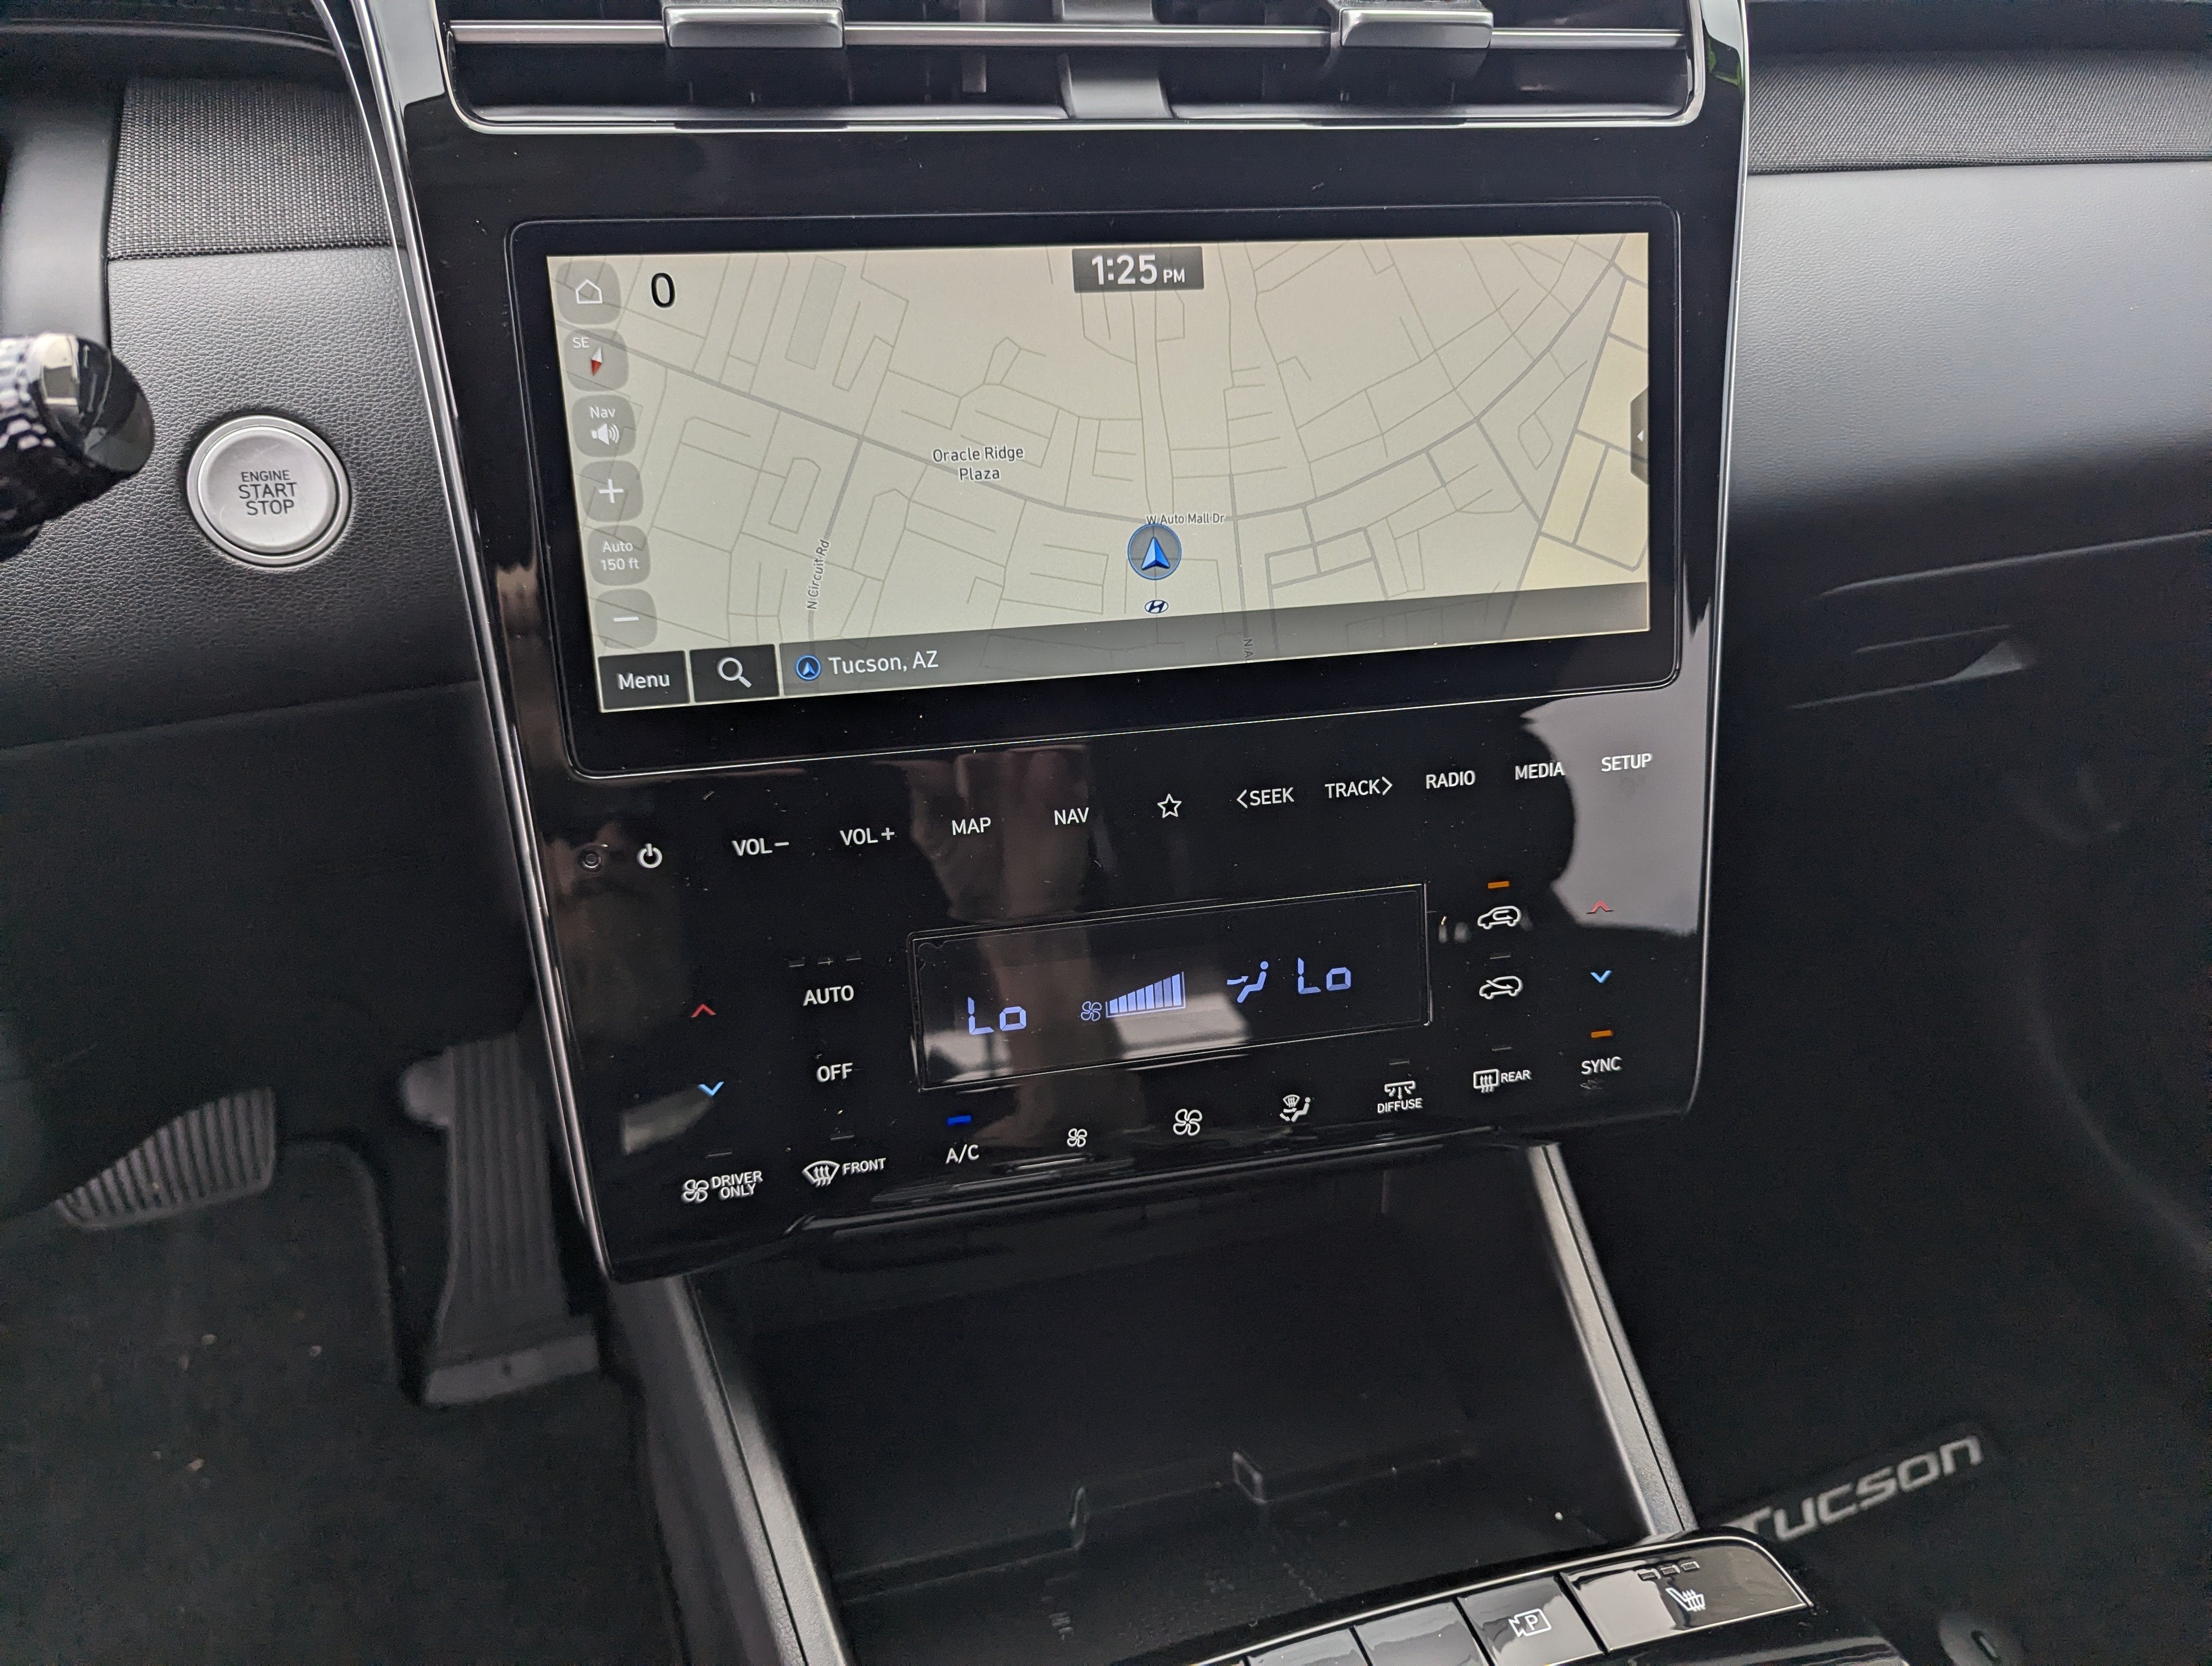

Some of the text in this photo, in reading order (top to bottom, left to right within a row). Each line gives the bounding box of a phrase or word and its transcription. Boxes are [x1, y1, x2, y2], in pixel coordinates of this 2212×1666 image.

[1091, 254, 1185, 285] 1:25 PM
[651, 272, 676, 309] 0
[572, 337, 590, 349] SE
[589, 406, 616, 418] Nav
[933, 446, 1024, 462] Oracle Ridge
[241, 470, 291, 482] ENGINE
[959, 467, 1000, 480] Plaza
[239, 483, 297, 499] START
[246, 499, 295, 515] STOP
[1146, 513, 1225, 524] W Auto Mall Dr
[602, 541, 633, 552] Auto
[601, 558, 640, 571] 150 ft
[807, 539, 830, 610] N Circuit Rd
[828, 650, 938, 675] Tucson, AZ
[617, 672, 670, 690] Menu
[1515, 761, 1566, 780] MEDIA
[1601, 753, 1652, 772] SETUP
[1425, 770, 1476, 789] RADIO
[1053, 807, 1089, 825] NAV
[952, 817, 992, 836] MAP
[802, 984, 854, 1007] AUTO
[816, 1062, 853, 1082] OFF
[1581, 1056, 1622, 1075] SYNC
[1501, 1069, 1532, 1083] REAR
[1377, 1097, 1423, 1113] DIFFUSE
[946, 1144, 980, 1164] A/C
[842, 1157, 886, 1176] FRONT
[710, 1170, 763, 1189] DRIVER
[719, 1182, 756, 1201] ONLY
